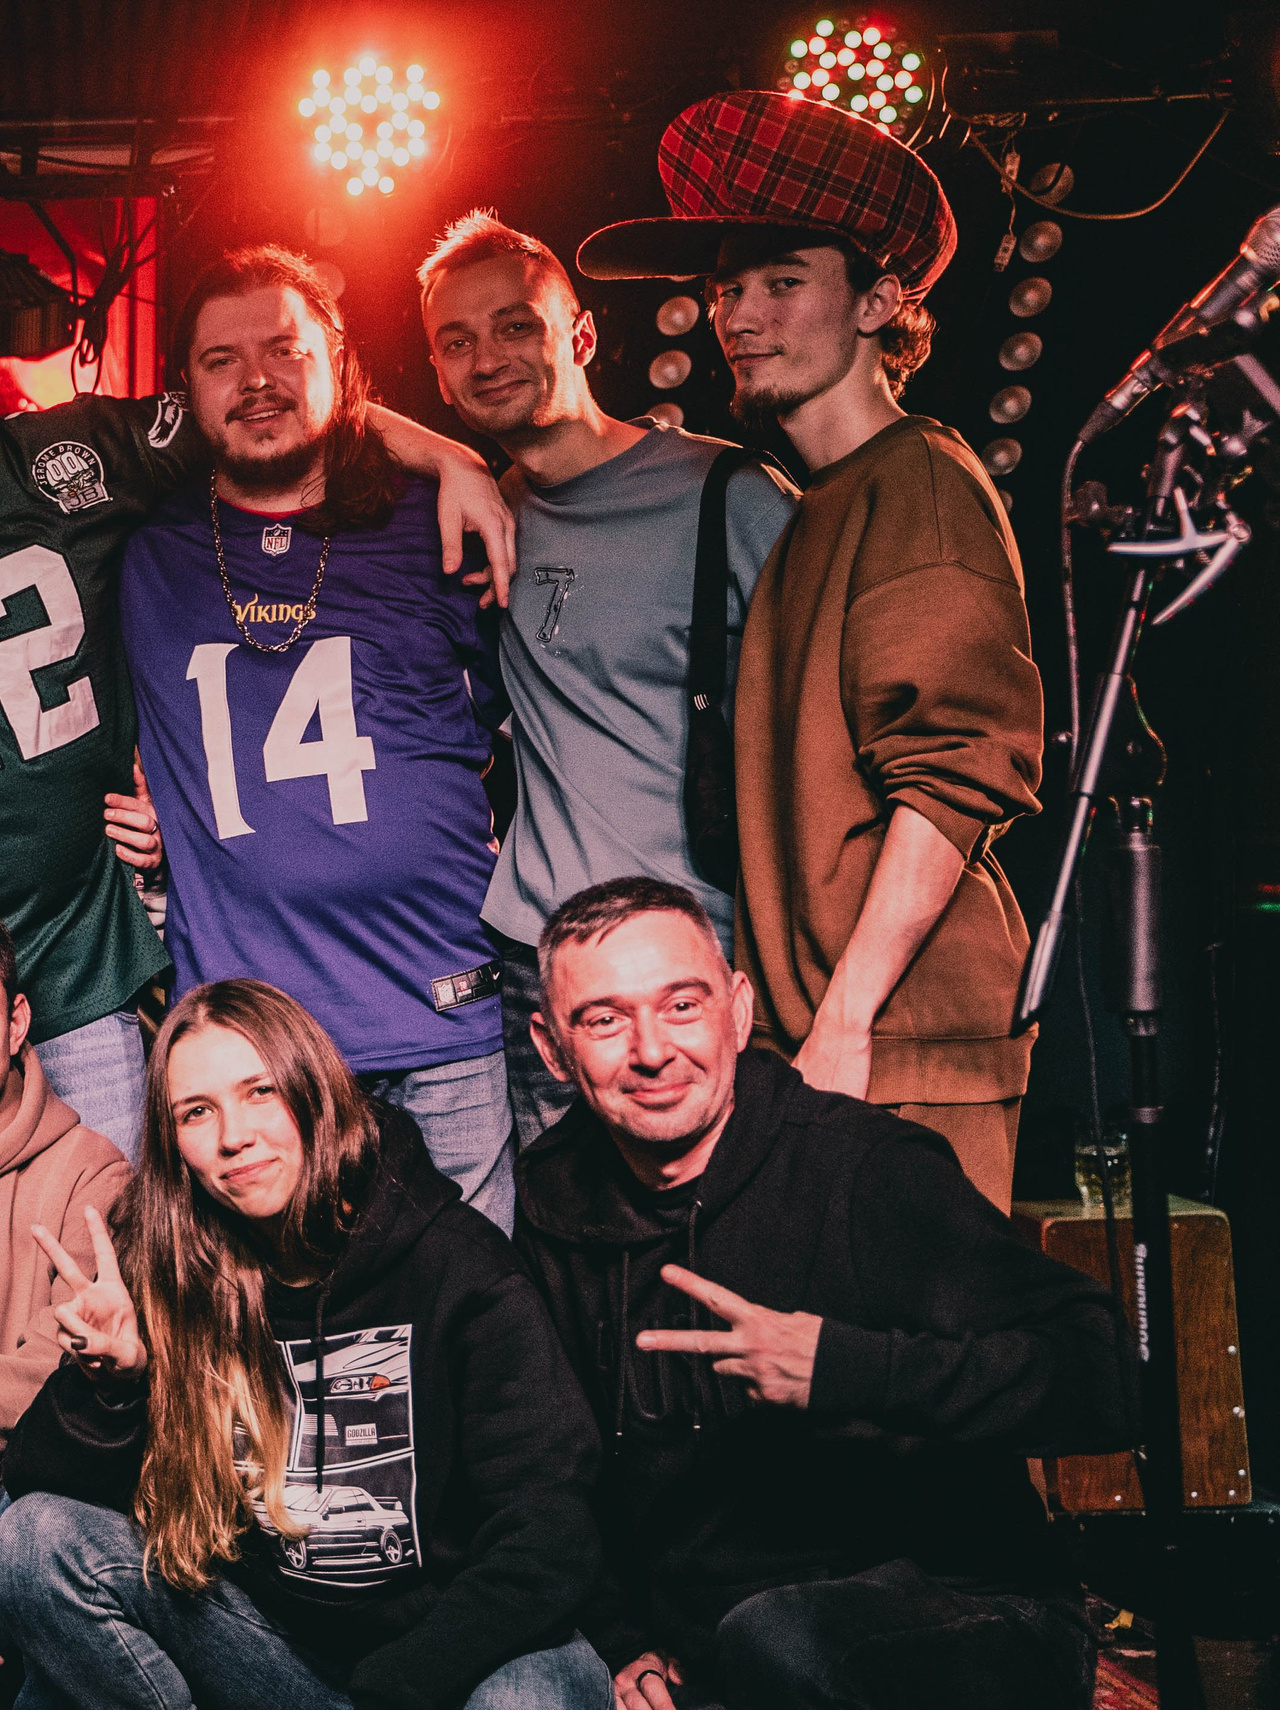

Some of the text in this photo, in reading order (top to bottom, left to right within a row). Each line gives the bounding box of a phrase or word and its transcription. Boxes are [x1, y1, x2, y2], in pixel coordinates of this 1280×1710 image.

[36, 445, 96, 485] JEROME BROWN
[266, 537, 286, 549] NFL
[534, 567, 575, 643] 7
[185, 636, 377, 839] 14
[347, 1427, 376, 1438] GODZILLA
